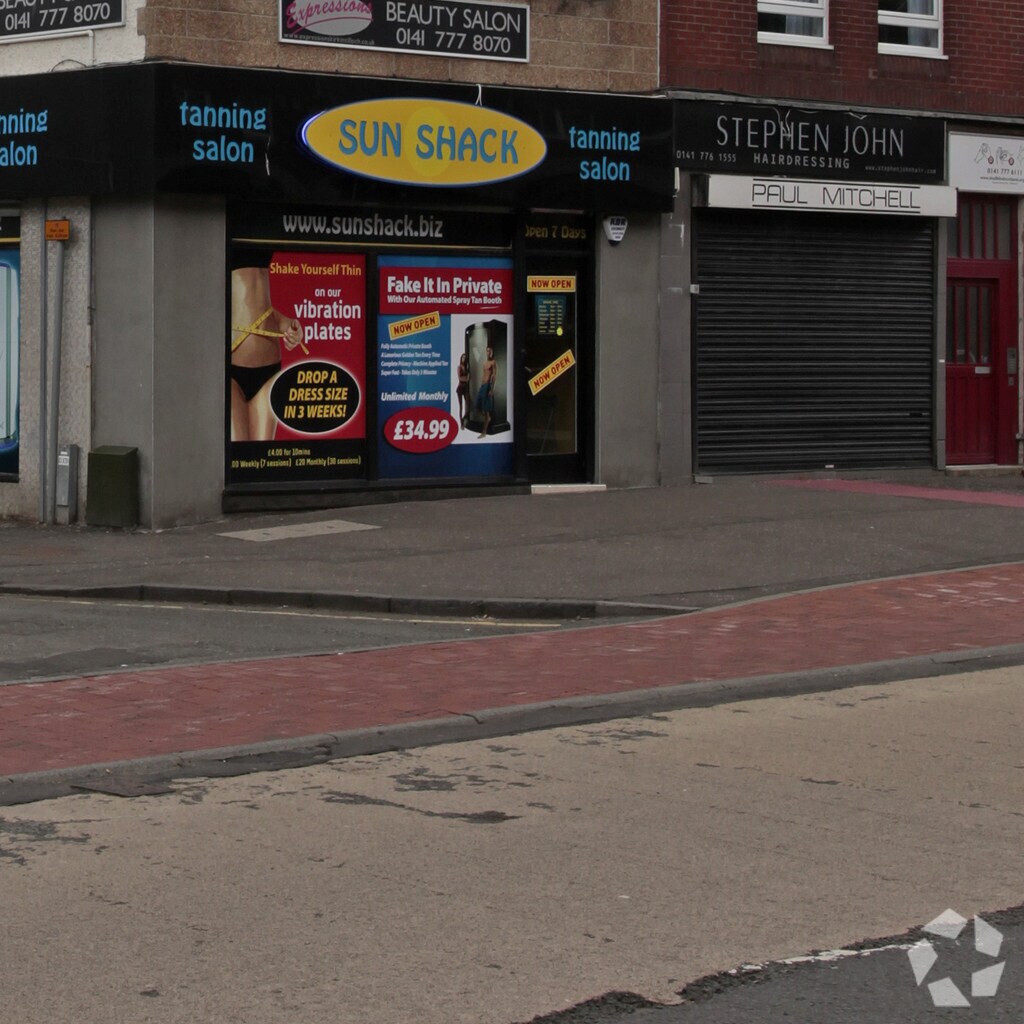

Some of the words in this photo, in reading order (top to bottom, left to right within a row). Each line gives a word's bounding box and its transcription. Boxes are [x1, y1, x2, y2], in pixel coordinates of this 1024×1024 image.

[5, 12, 30, 31] 0141
[39, 7, 68, 27] 777
[73, 2, 110, 24] 8070
[386, 1, 458, 28] BEAUTY
[463, 8, 521, 34] SALON
[396, 28, 425, 46] 0141
[435, 31, 466, 50] 777
[472, 34, 511, 54] 8070
[179, 101, 267, 132] tanning
[339, 119, 401, 157] SUN
[415, 123, 519, 165] SHACK
[569, 125, 641, 152] tanning
[716, 115, 829, 153] STEPHEN
[843, 125, 904, 157] JOHN
[192, 134, 254, 162] salon
[676, 150, 695, 160] 0141
[700, 151, 714, 161] 776
[579, 155, 630, 181] salon
[753, 152, 850, 169] HAIRDRESSING
[752, 184, 808, 204] PAUL
[823, 187, 921, 209] MITCHELL
[283, 214, 443, 238] www.sunshack.biz
[551, 225, 558, 238] 7
[561, 225, 587, 240] Days
[270, 263, 299, 274] Shake
[301, 263, 339, 275] Yourself
[341, 264, 361, 276] Thin
[315, 289, 325, 297] on
[327, 289, 341, 297] our
[387, 276, 421, 293] Fake
[423, 277, 434, 293] It
[437, 277, 450, 293] In
[453, 277, 502, 294] Private
[531, 280, 549, 288] NOW
[551, 280, 572, 288] OPEN
[294, 299, 361, 319] vibration
[387, 295, 402, 303] With
[416, 295, 452, 304] Automated
[453, 296, 470, 305] Spray
[471, 296, 482, 304] Tan
[483, 296, 502, 304] Booth
[304, 322, 351, 343] plates
[393, 324, 412, 335] NOW
[414, 316, 436, 328] OPEN
[297, 371, 328, 384] DROP
[329, 371, 337, 383] A
[533, 373, 550, 389] NOW
[551, 355, 570, 376] OPEN
[289, 388, 323, 401] DRESS
[325, 387, 348, 401] SIZE
[381, 392, 416, 401] Unlimited
[418, 391, 448, 402] Monthly
[284, 406, 296, 418] IN
[297, 405, 304, 418] 3
[307, 404, 347, 418] WEEKS!
[393, 419, 450, 440] £34.99
